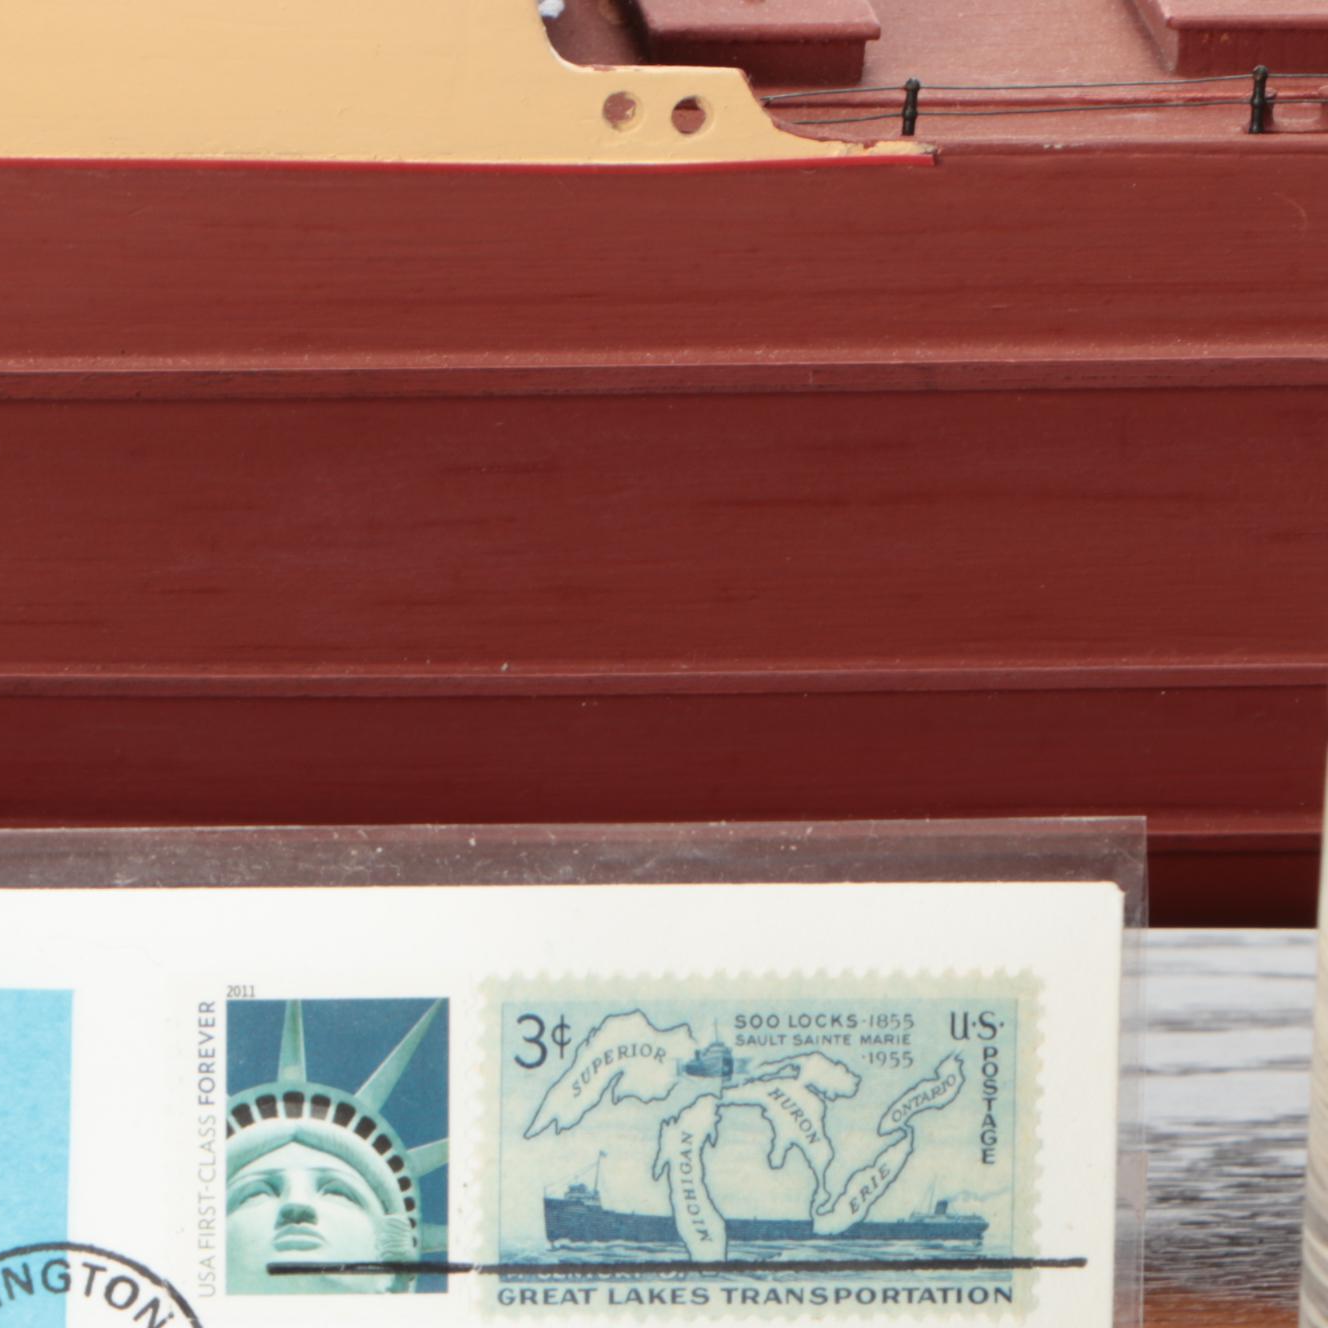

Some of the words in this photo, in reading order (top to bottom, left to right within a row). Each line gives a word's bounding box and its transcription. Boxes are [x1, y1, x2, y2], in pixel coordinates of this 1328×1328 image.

[227, 985, 256, 998] 2011
[514, 1013, 571, 1069] 3¢
[734, 1014, 779, 1029] SOO
[789, 1014, 858, 1029] LOCKS
[735, 1034, 785, 1046] SAULT
[793, 1034, 851, 1046] SAINTE
[860, 1034, 911, 1045] MARIE
[198, 1000, 216, 1105] FOREVER
[571, 1043, 667, 1098] SUPERIOR
[767, 1088, 820, 1144] HURON
[892, 1074, 957, 1122] ONTARIO
[980, 1046, 999, 1165] POSTAGE
[198, 1114, 216, 1252] FIRST-CLASS
[680, 1131, 712, 1243] MICHIGAN
[849, 1164, 891, 1215] ERIE
[198, 1256, 216, 1297] USA
[497, 1286, 598, 1306] GREAT
[608, 1286, 710, 1306] LAKES
[720, 1286, 1014, 1306] TRANSPORTATION
